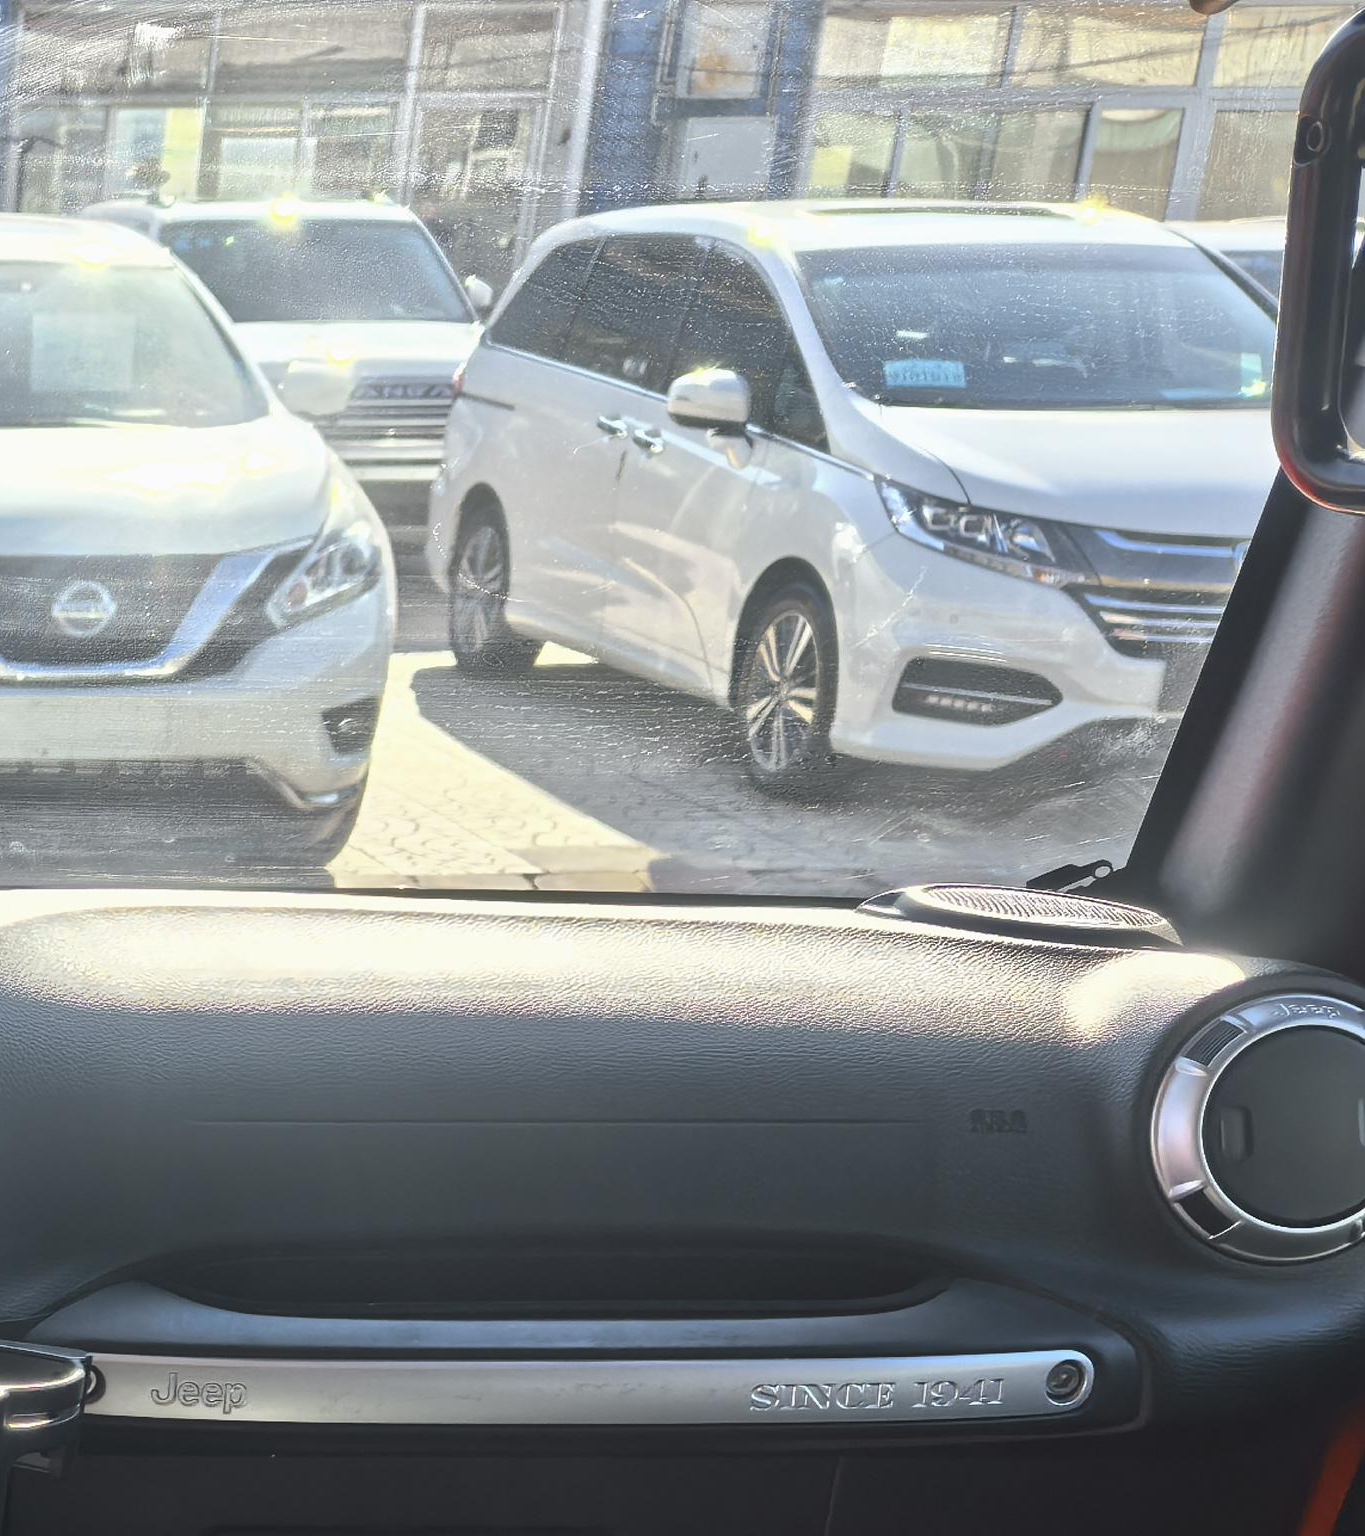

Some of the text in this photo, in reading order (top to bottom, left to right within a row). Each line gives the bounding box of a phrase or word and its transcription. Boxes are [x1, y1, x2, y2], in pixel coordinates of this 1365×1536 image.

[150, 1371, 248, 1415] Jeep
[750, 1378, 1005, 1412] SINCE 1941
